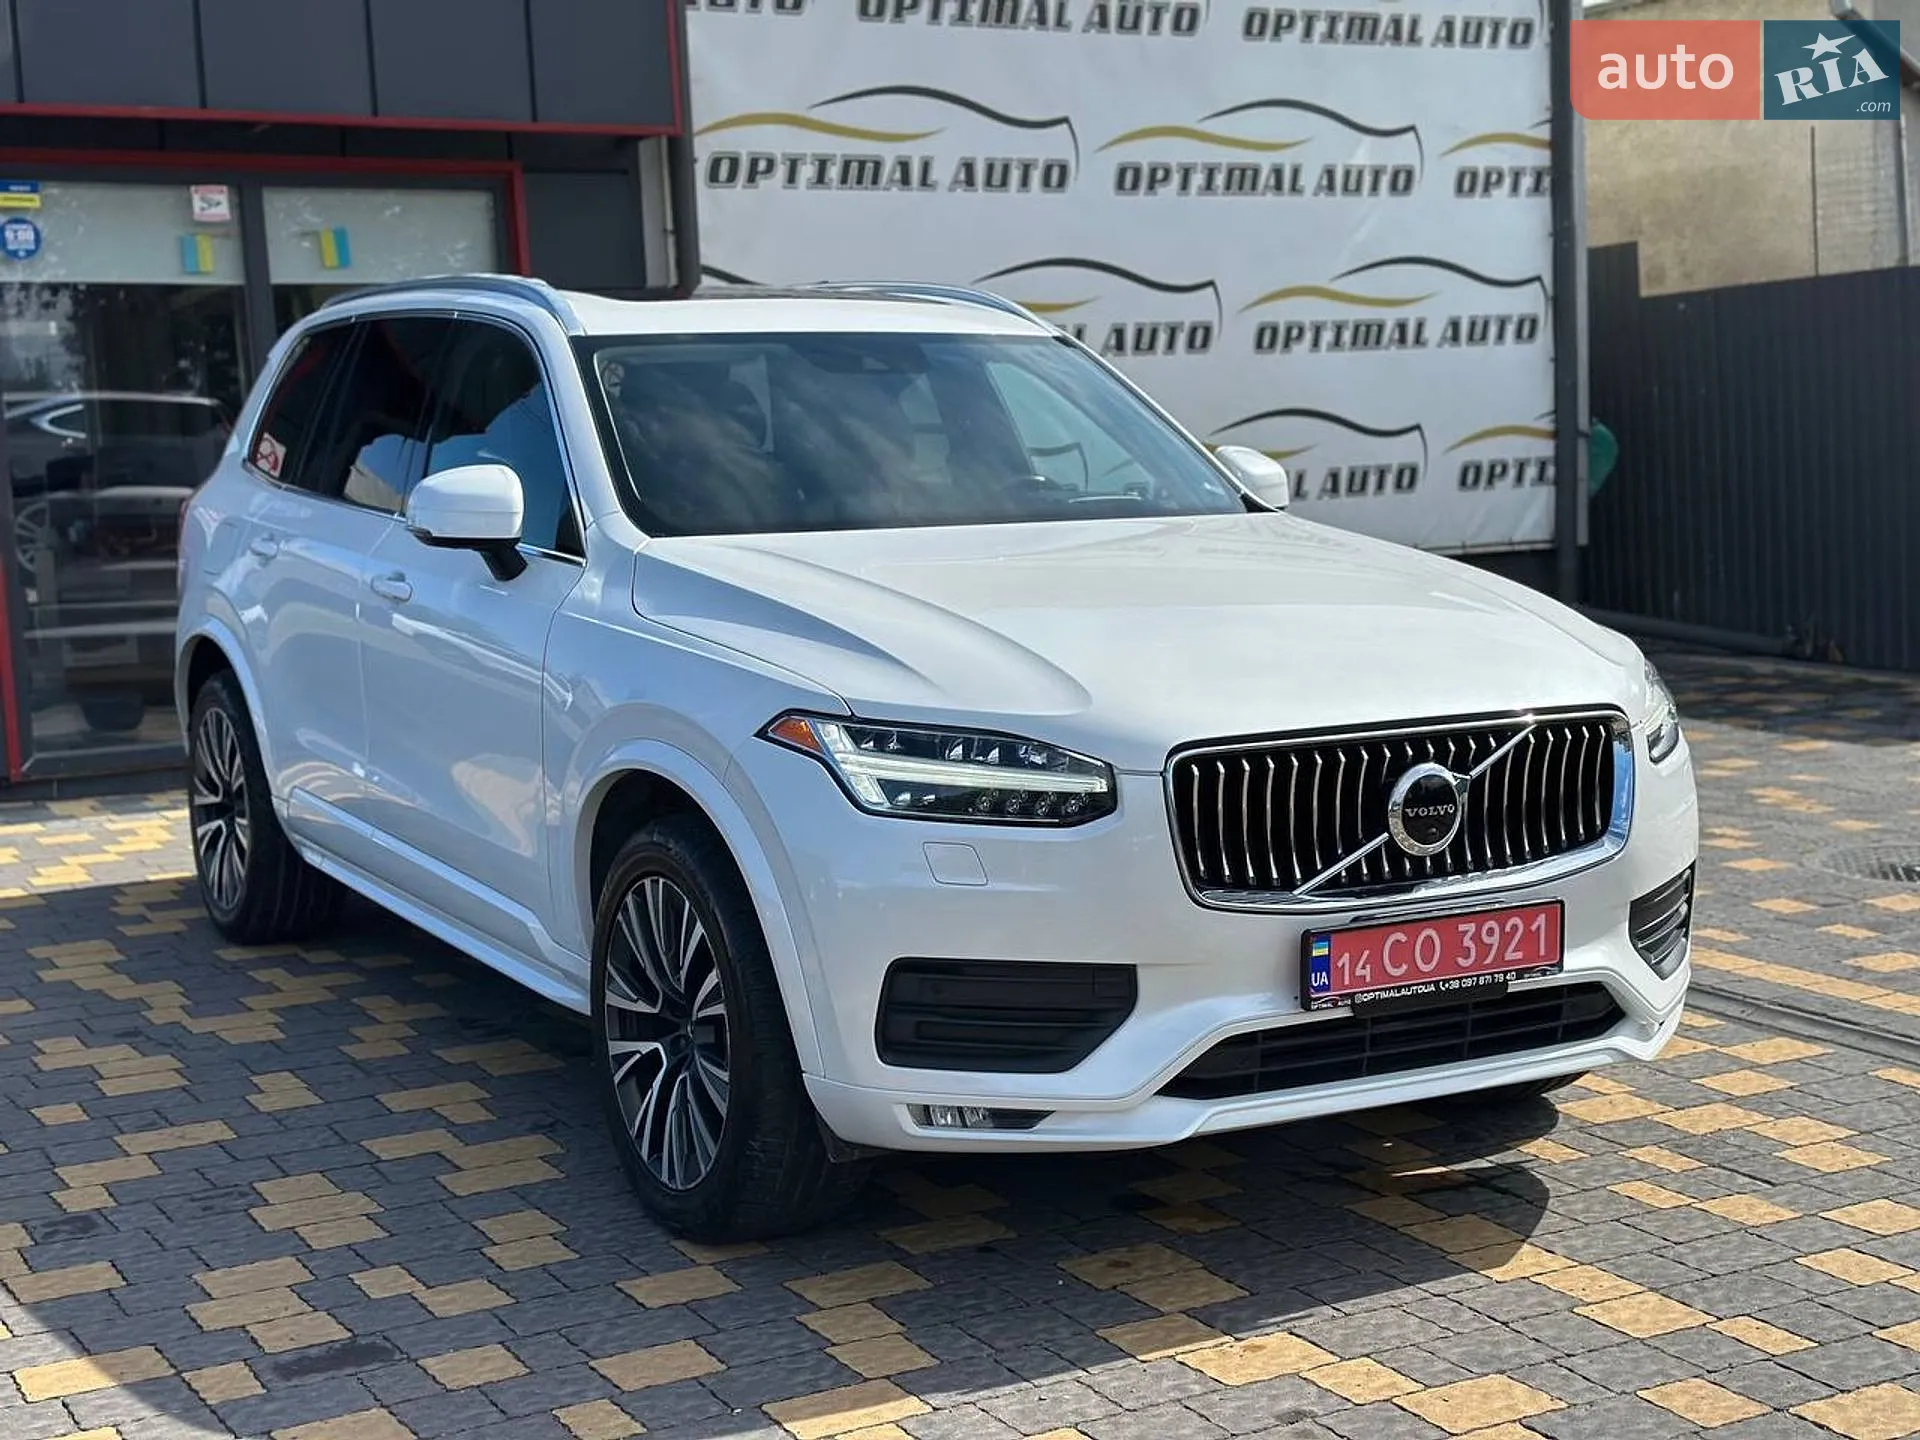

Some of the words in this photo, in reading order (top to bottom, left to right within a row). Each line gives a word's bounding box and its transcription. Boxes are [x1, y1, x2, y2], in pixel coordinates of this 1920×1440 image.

[1081, 0, 1201, 36] AUTO
[1243, 8, 1423, 47] OPTIMAL
[1431, 17, 1536, 50] AUTO
[705, 151, 938, 192] OPTIMAL
[948, 157, 1071, 193] AUTO
[1114, 161, 1305, 197] OPTIMAL
[1313, 164, 1416, 197] AUTO
[1101, 321, 1213, 357] AUTO
[1254, 317, 1429, 355] OPTIMAL
[1438, 313, 1540, 347] AUTO
[1318, 463, 1420, 499] AUTO
[1404, 803, 1456, 818] VOLVO
[1336, 950, 1371, 986] 14
[1382, 929, 1441, 977] CO
[1456, 913, 1548, 968] 3921
[1311, 971, 1329, 987] UA
